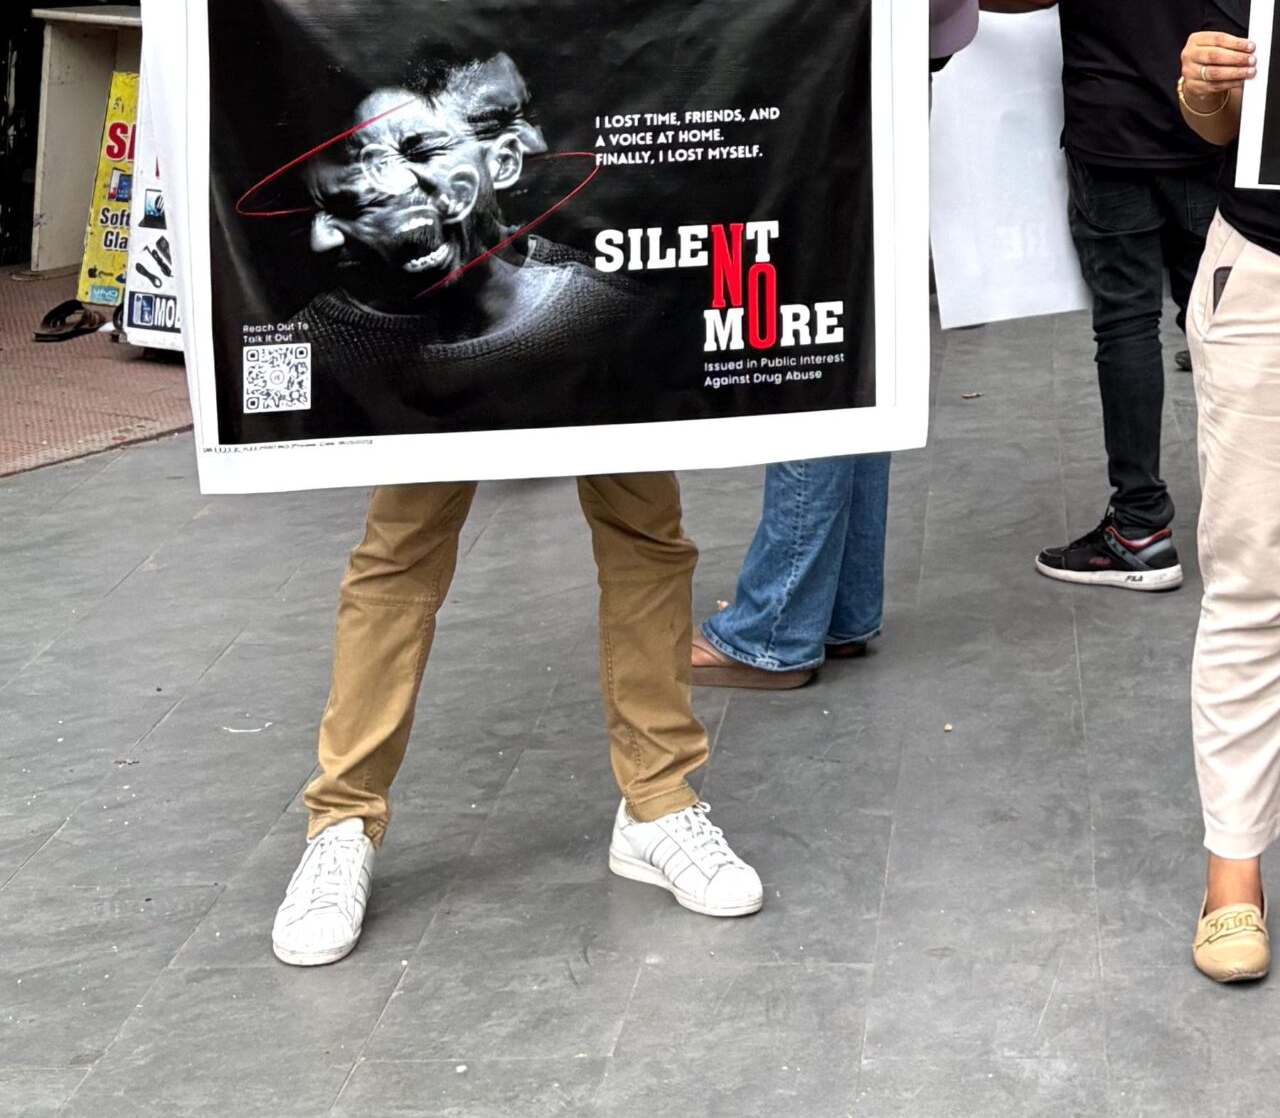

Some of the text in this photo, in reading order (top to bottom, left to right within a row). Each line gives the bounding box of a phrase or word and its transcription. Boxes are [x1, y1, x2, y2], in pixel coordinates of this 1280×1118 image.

[596, 108, 780, 128] I LOST TIME, FRIENDS, AND
[596, 129, 724, 147] A VOICE AT HOME.
[596, 146, 763, 166] FINALLY, I LOST MYSELF.
[594, 220, 780, 308] SILENT
[704, 262, 844, 352] MORE
[276, 322, 295, 331] Out
[297, 321, 309, 331] To
[274, 333, 293, 342] Out
[704, 354, 844, 372] Issued in Public Interest
[704, 370, 822, 388] Against Drug Abuse
